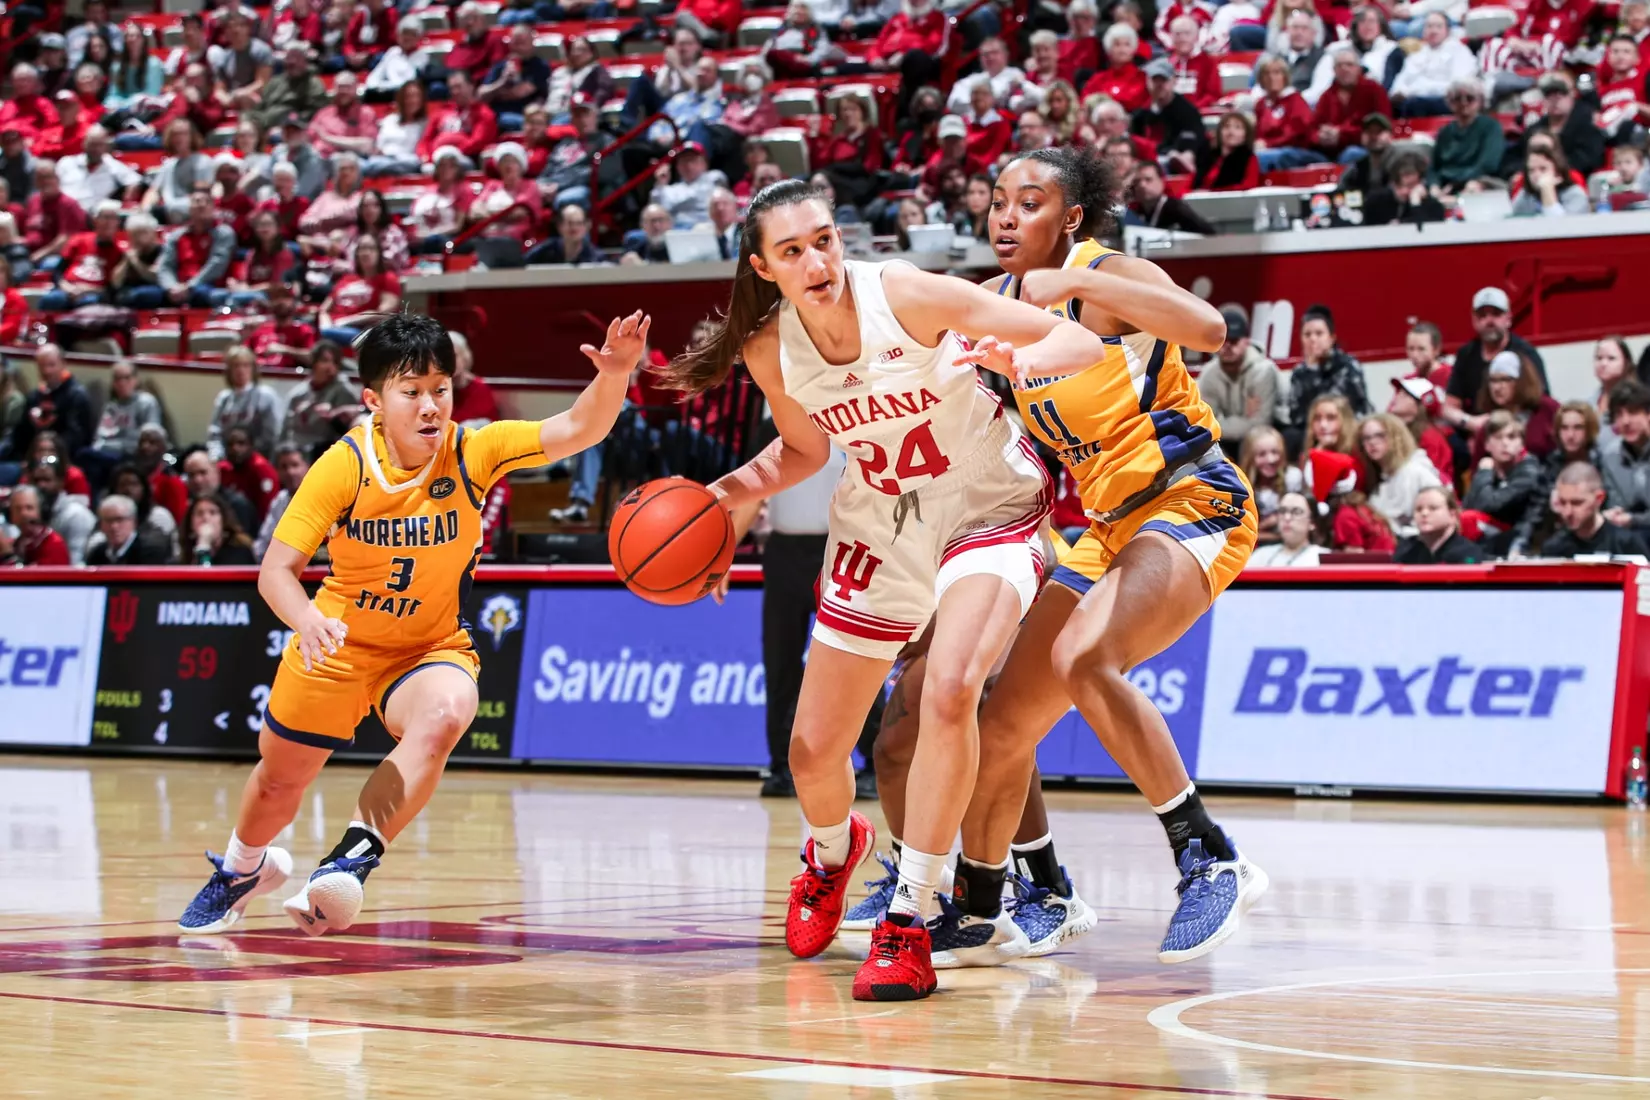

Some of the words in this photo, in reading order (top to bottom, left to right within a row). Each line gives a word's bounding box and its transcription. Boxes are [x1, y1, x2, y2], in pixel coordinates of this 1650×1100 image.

[809, 388, 942, 435] NDIANA
[1028, 399, 1084, 446] 11
[848, 418, 951, 496] 24
[1055, 440, 1102, 467] TATE
[346, 509, 459, 548] MOREHEAD
[386, 556, 416, 593] 3
[157, 602, 251, 626] INDIANA
[355, 589, 423, 618] STATE
[178, 646, 218, 680] 59
[96, 690, 142, 707] FOULS
[533, 645, 684, 719] Saving
[1123, 667, 1188, 716] es
[1232, 646, 1586, 719] Baxter
[158, 688, 173, 713] 3
[477, 701, 506, 718] ULS
[153, 720, 169, 744] 4
